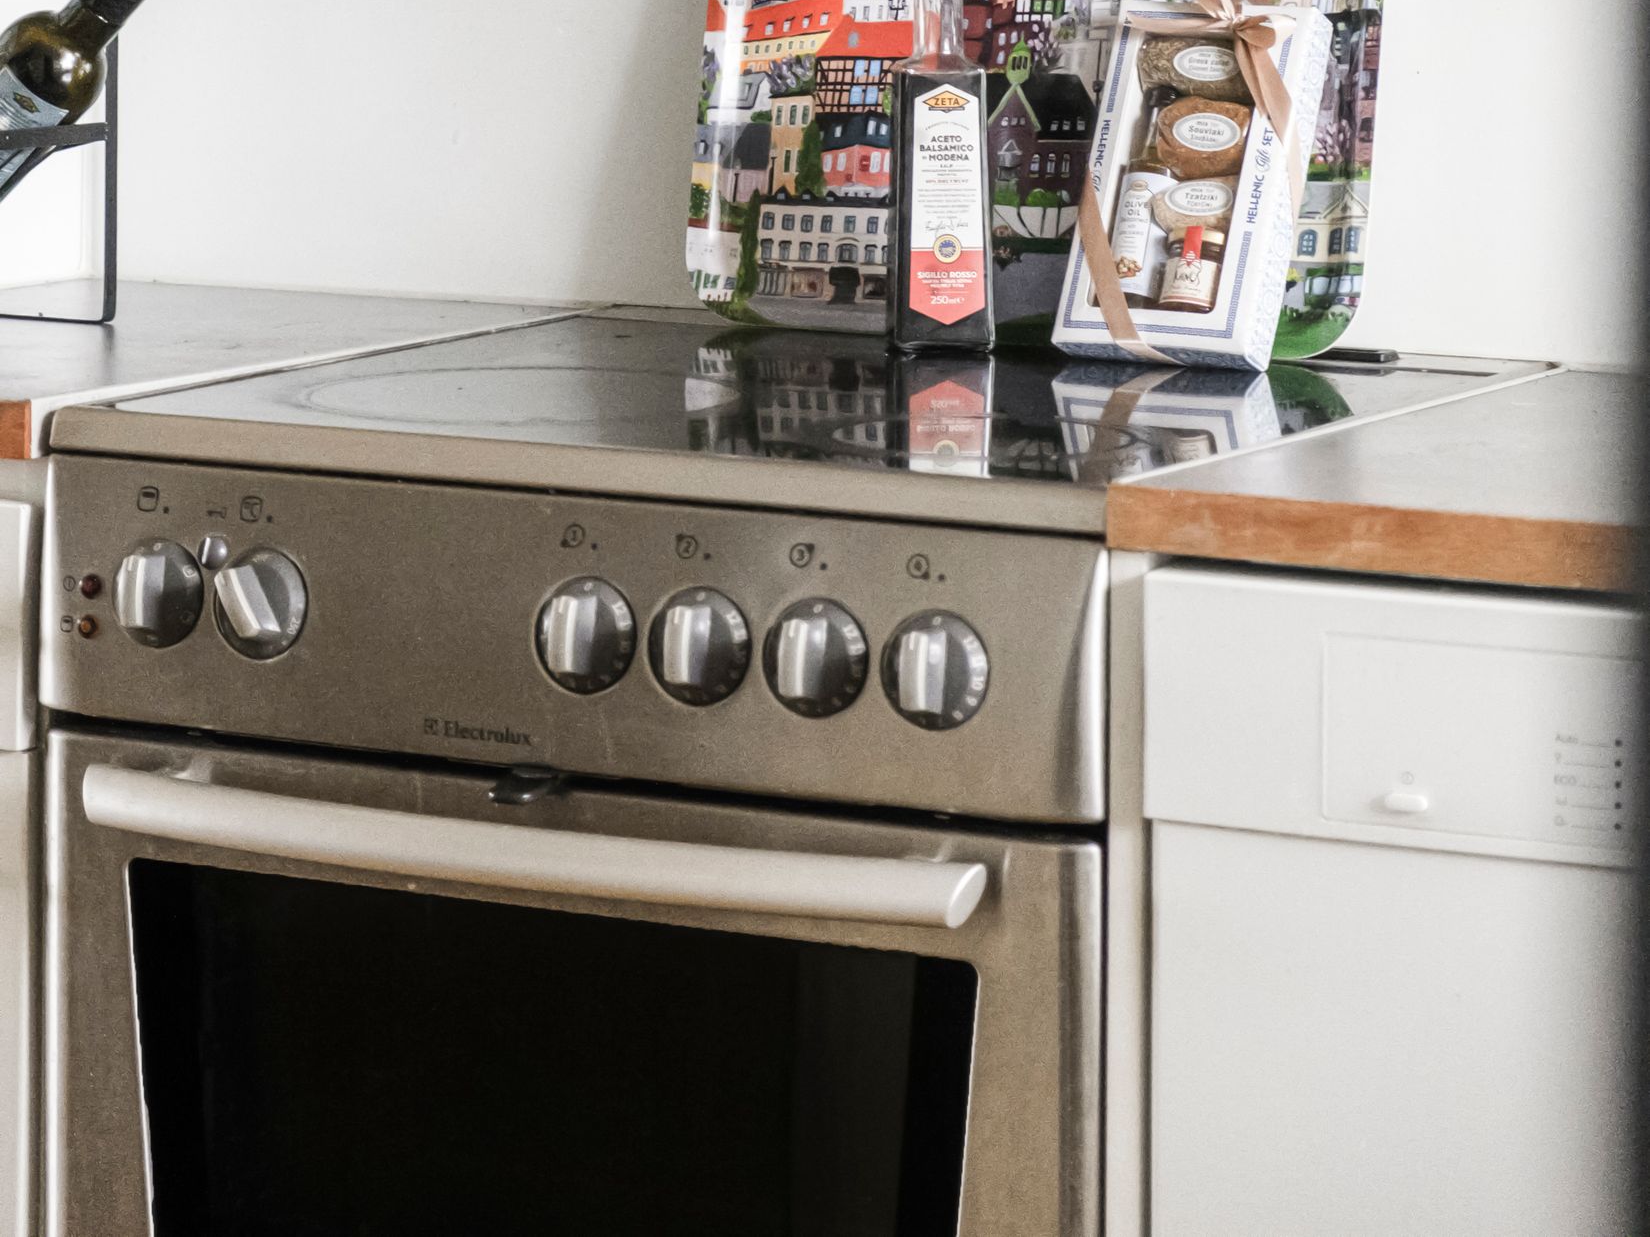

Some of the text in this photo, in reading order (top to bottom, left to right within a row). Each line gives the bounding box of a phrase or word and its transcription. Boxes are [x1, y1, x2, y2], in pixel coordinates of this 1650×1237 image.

[934, 97, 960, 106] ZETA
[1188, 124, 1225, 136] Souvlaki
[930, 135, 962, 143] ACETO
[1093, 119, 1112, 168] HELLENIC
[919, 144, 974, 152] BALSAMICO
[928, 153, 970, 161] MODENA
[1246, 174, 1265, 224] HELLENIC
[1261, 127, 1274, 147] SET
[1184, 192, 1218, 201] Tzatziki
[1127, 208, 1142, 216] OIL
[917, 271, 977, 279] SIGILLO ROSSO
[444, 720, 533, 746] Electrolux
